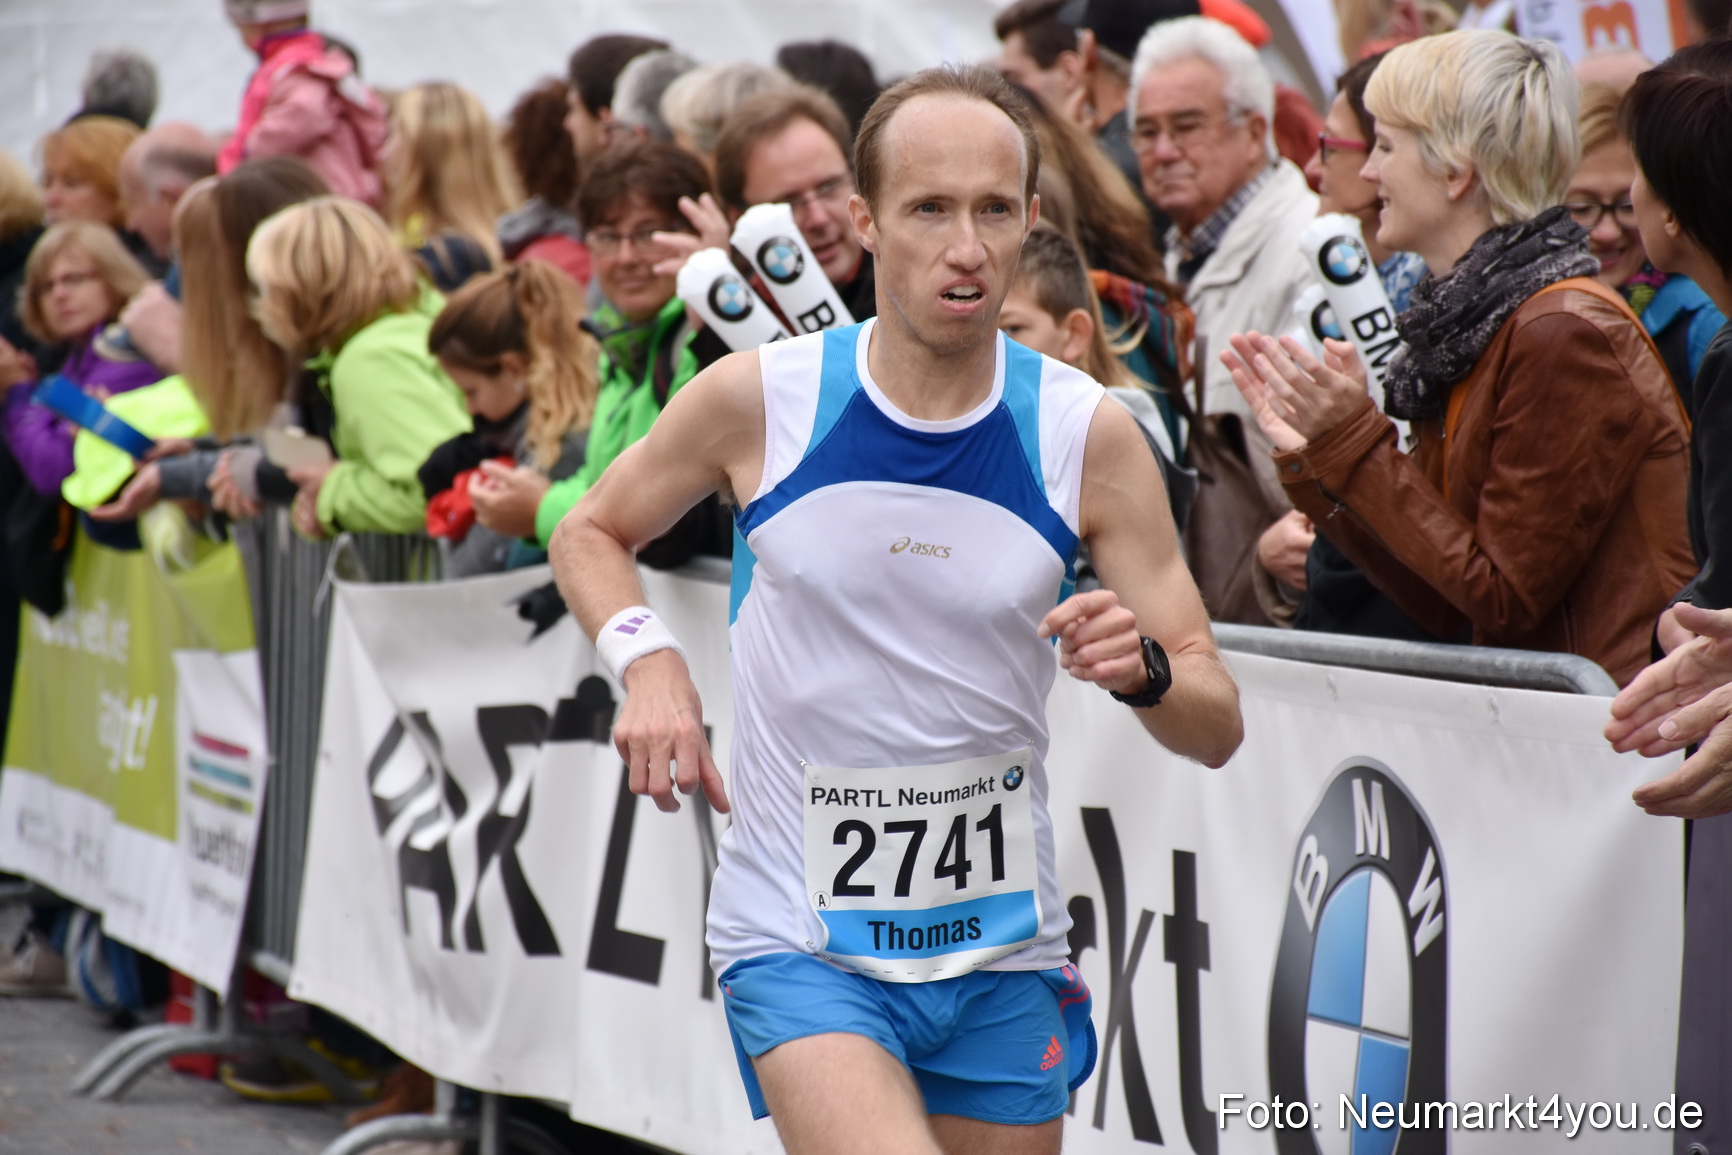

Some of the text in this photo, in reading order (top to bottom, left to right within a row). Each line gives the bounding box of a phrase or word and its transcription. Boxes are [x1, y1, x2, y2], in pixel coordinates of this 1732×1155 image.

[910, 542, 952, 559] asics
[811, 776, 996, 808] PARTL Neumarkt
[832, 803, 1006, 898] 2741
[1294, 778, 1445, 956] BMW
[818, 894, 827, 908] A
[867, 916, 983, 951] Thomas
